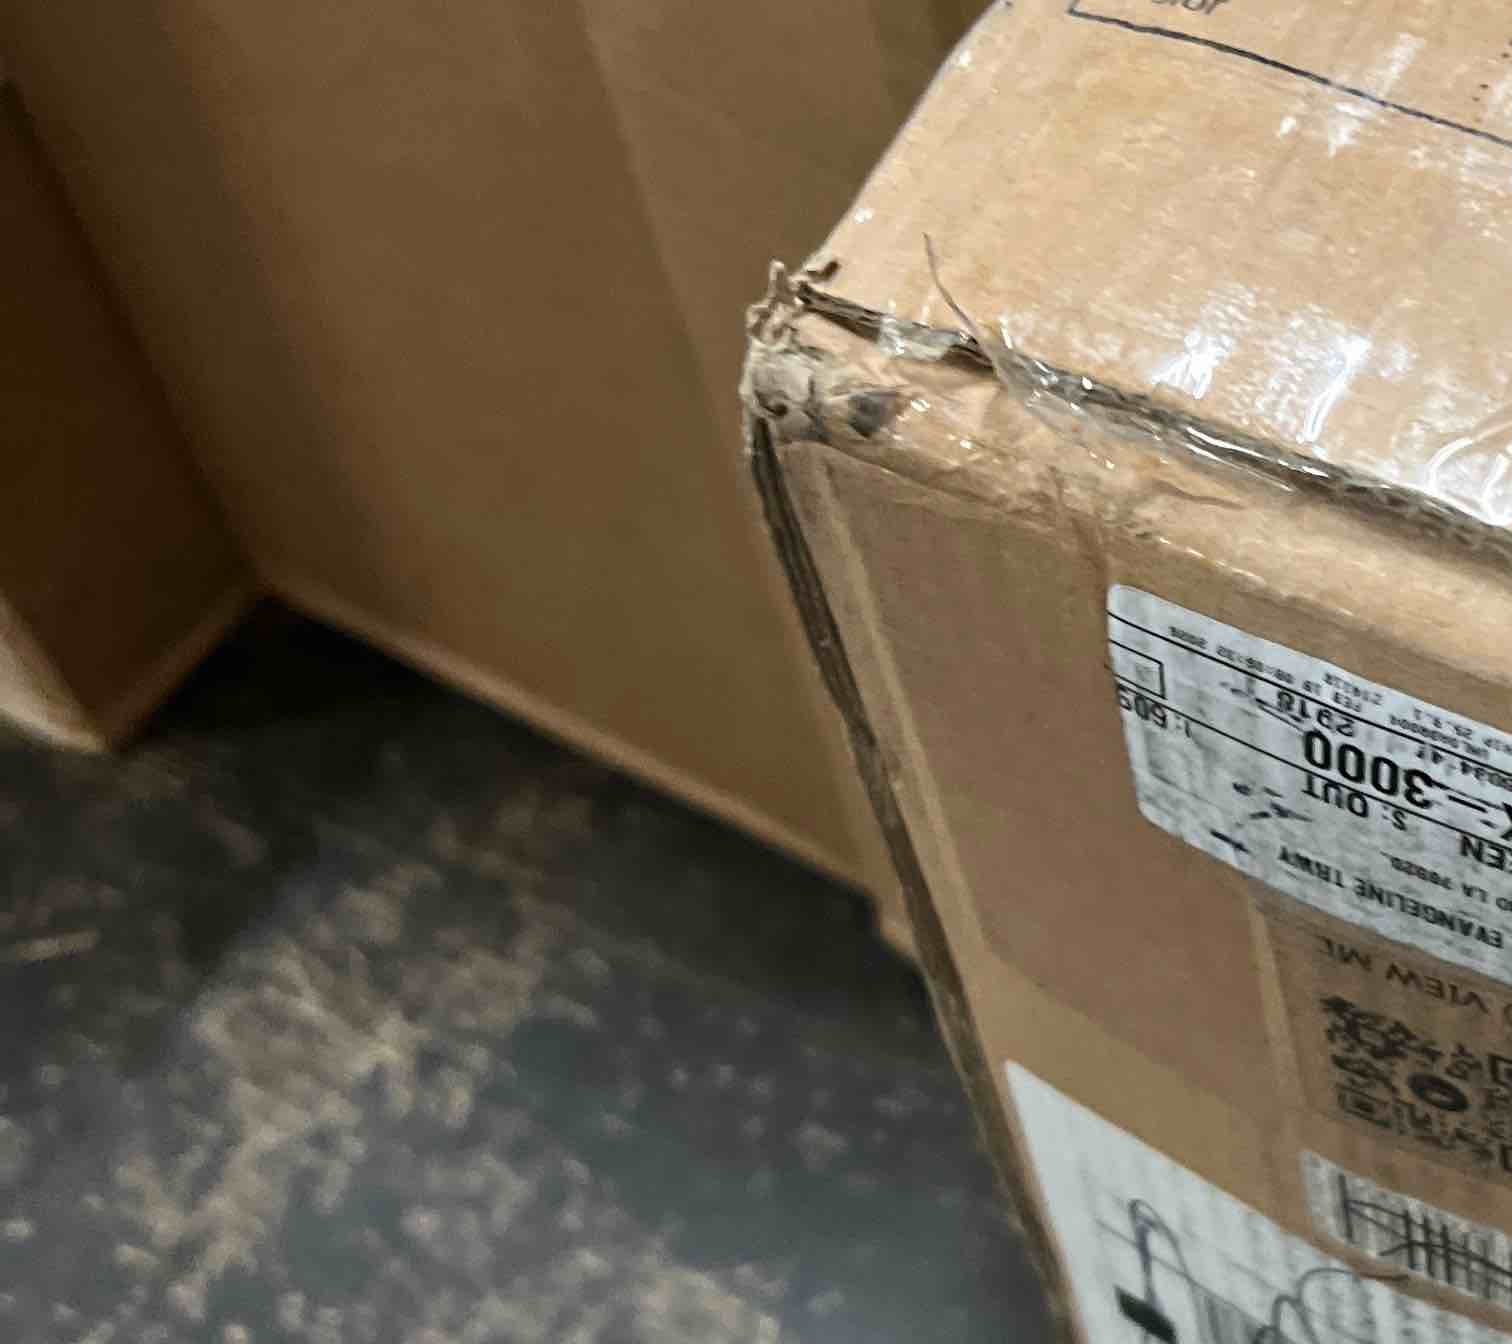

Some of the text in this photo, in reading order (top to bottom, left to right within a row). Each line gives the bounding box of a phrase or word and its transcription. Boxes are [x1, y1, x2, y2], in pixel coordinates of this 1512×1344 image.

[1300, 773, 1369, 819] OUT
[1353, 875, 1505, 950] EVANGELINE
[1384, 959, 1489, 1014] VIEW
